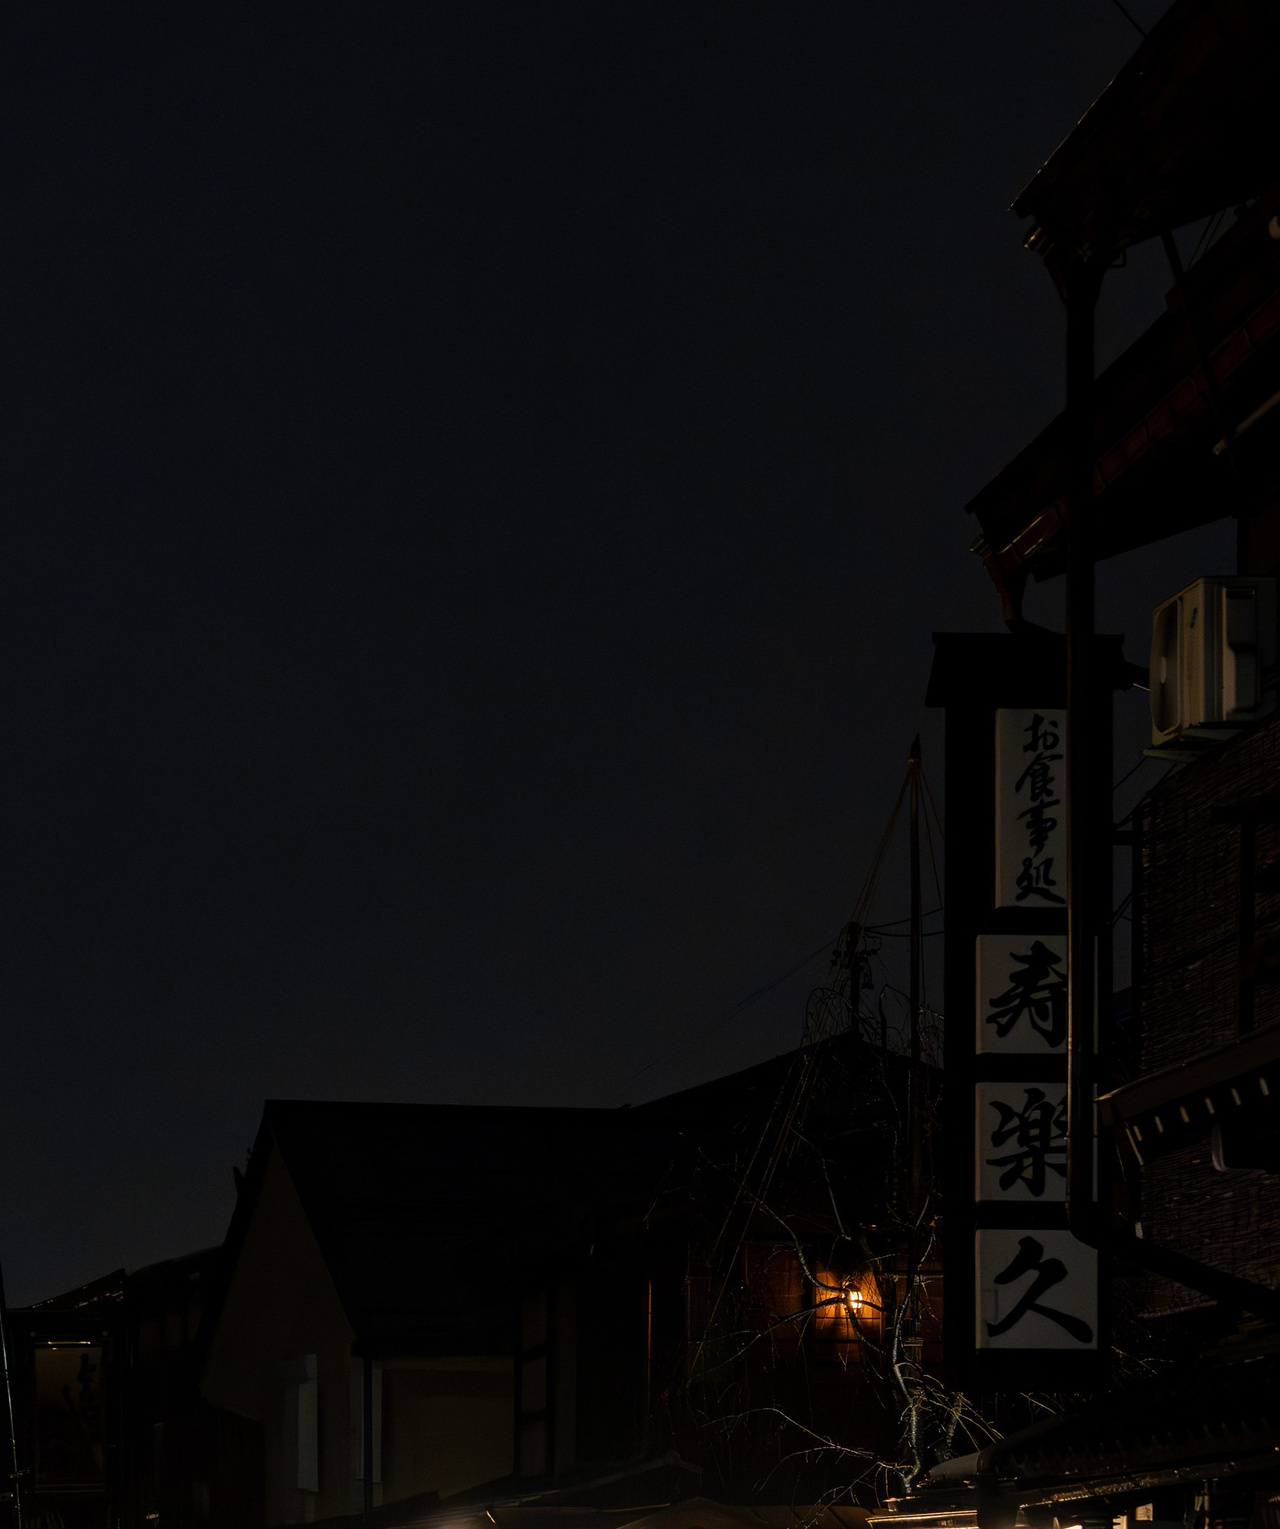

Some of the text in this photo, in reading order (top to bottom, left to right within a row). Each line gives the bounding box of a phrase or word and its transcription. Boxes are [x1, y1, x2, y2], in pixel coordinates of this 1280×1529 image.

[1015, 713, 1066, 905] お食事処
[985, 940, 1093, 1344] 寿楽久
